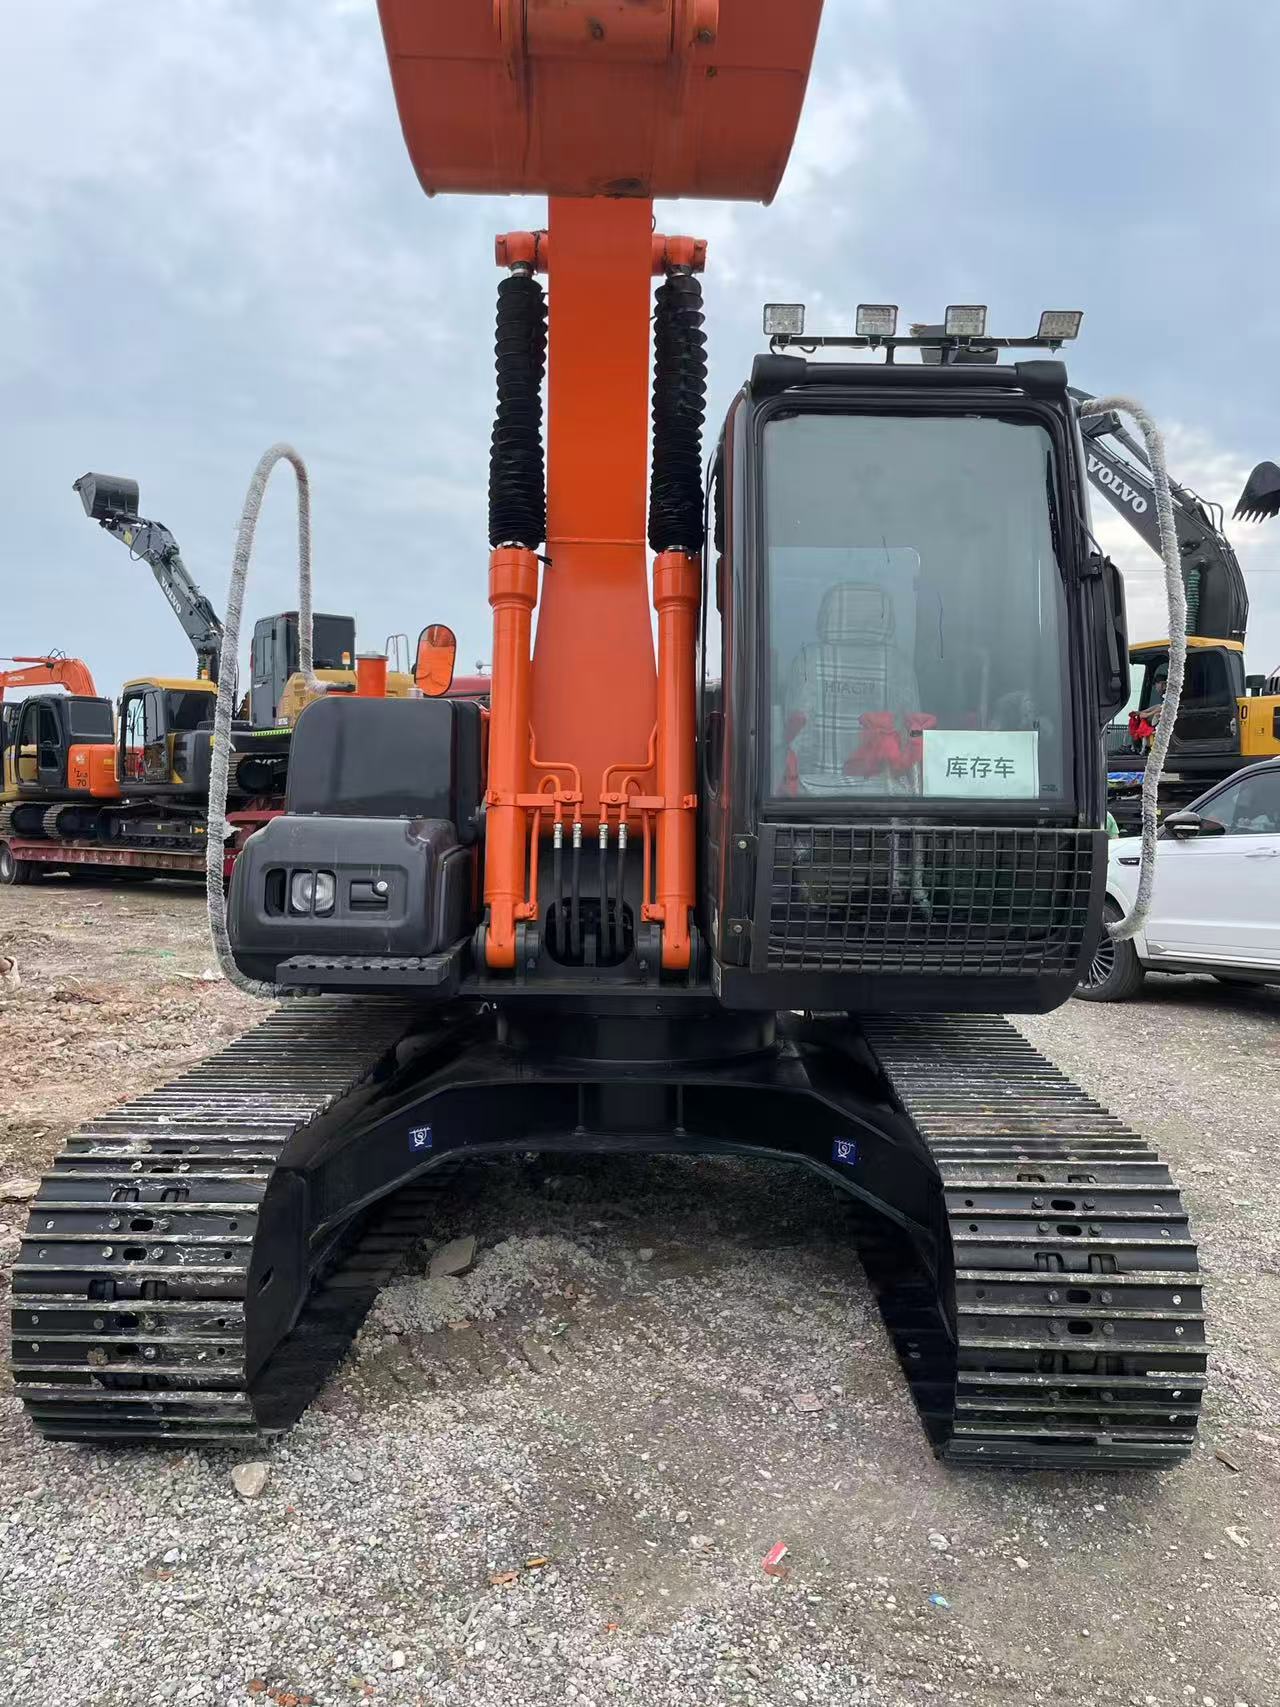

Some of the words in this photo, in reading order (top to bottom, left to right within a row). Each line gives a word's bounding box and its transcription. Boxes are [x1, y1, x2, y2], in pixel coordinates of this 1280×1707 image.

[1087, 453, 1148, 514] VOLVO
[945, 756, 1016, 779] 库存车
[77, 779, 87, 787] 70
